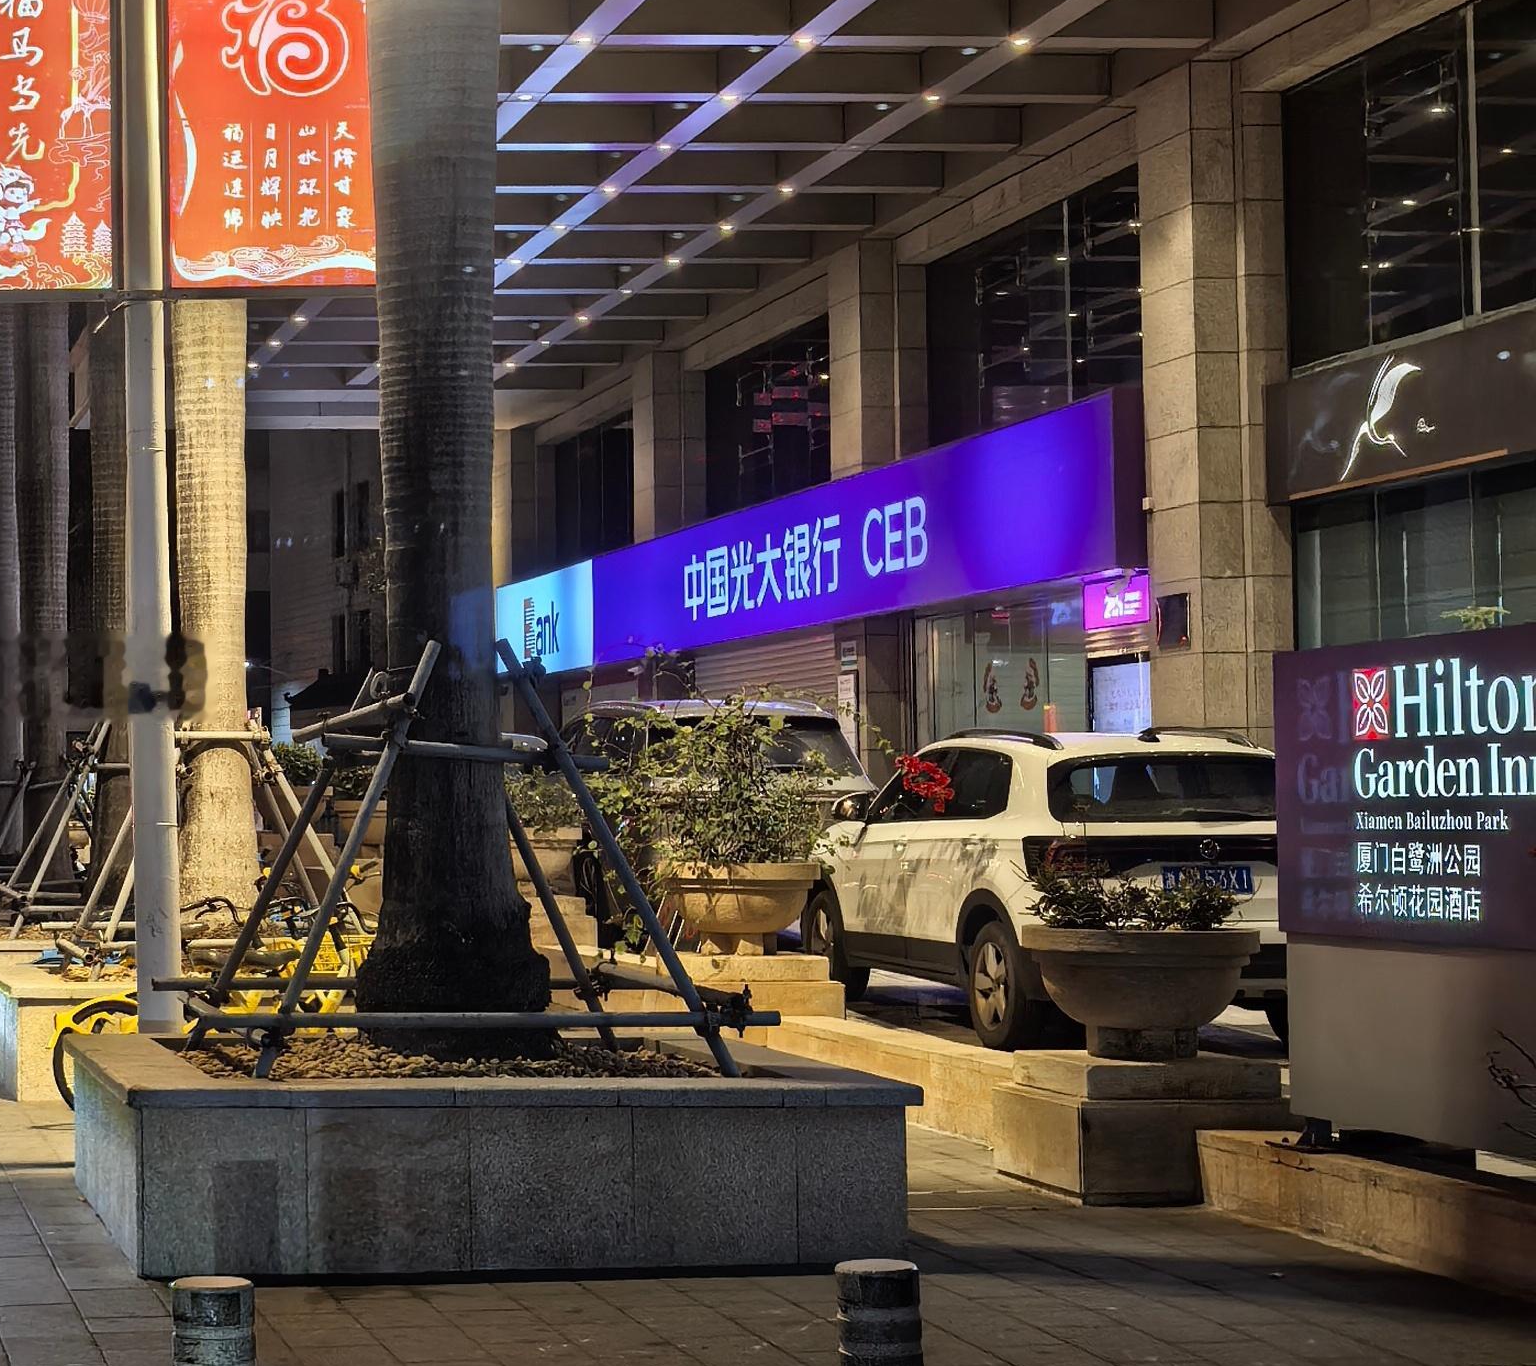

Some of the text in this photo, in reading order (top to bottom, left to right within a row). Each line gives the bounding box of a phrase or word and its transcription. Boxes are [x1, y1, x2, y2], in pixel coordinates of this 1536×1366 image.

[684, 496, 928, 621] 中国光大银行 CEB
[1354, 742, 1536, 799] Garden In
[1355, 809, 1510, 830] Xiamen Bailuzhou Park
[1356, 841, 1481, 877] 厦门白鹭洲公园
[1357, 883, 1481, 921] 希尔顿花园酒店
